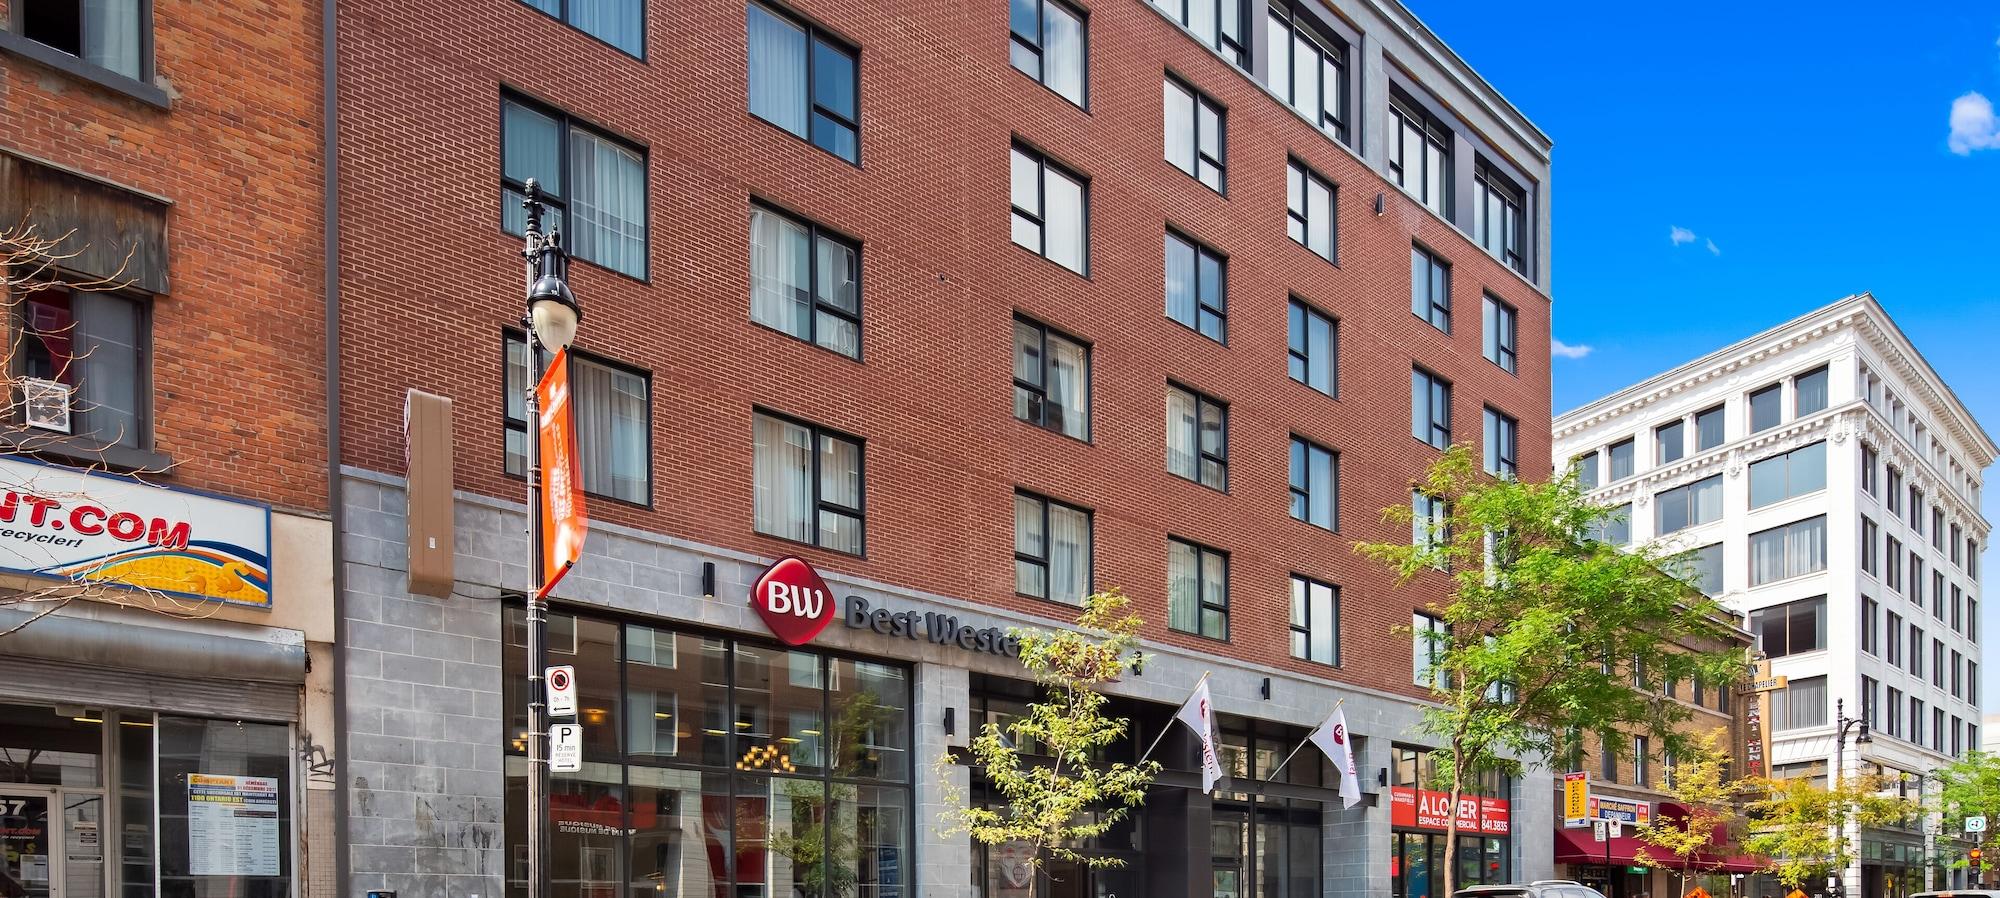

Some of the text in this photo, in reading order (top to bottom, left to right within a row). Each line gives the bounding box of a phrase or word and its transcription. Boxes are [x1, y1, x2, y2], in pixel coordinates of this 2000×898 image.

[767, 580, 824, 619] BW
[845, 595, 1020, 657] Best Weste
[561, 728, 572, 744] P
[556, 744, 563, 752] 15
[1419, 792, 1477, 819] À LOER
[1419, 816, 1477, 829] ESPACE COMERCIAL
